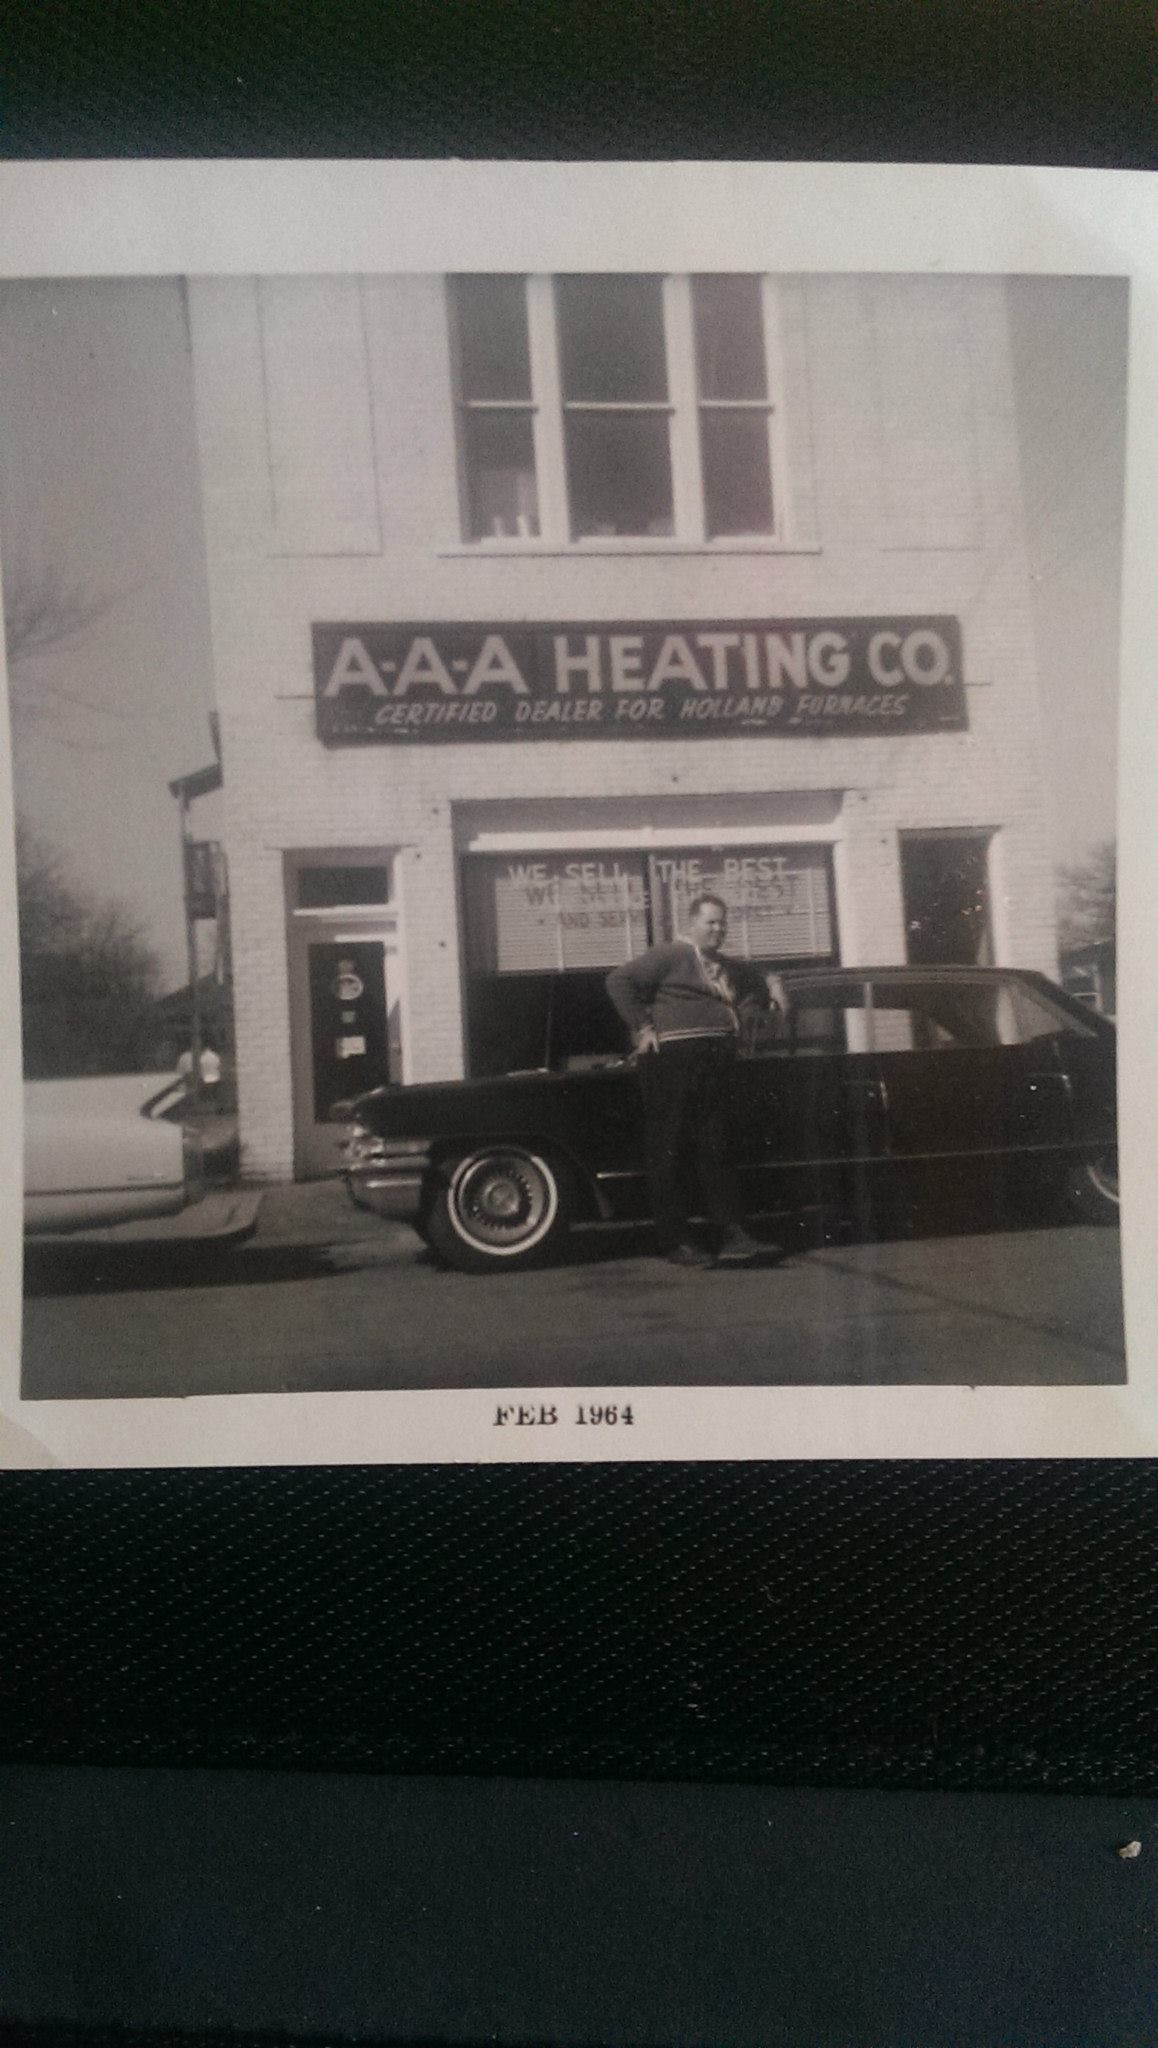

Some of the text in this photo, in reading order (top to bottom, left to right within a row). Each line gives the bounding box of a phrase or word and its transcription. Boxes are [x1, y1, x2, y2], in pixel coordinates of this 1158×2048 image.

[322, 629, 953, 697] A-A-A HEATING CO.
[374, 693, 910, 725] CERTIFIED DEALER FOR HOLLAND FURNACES
[507, 857, 787, 886] WE SELL THE BEST
